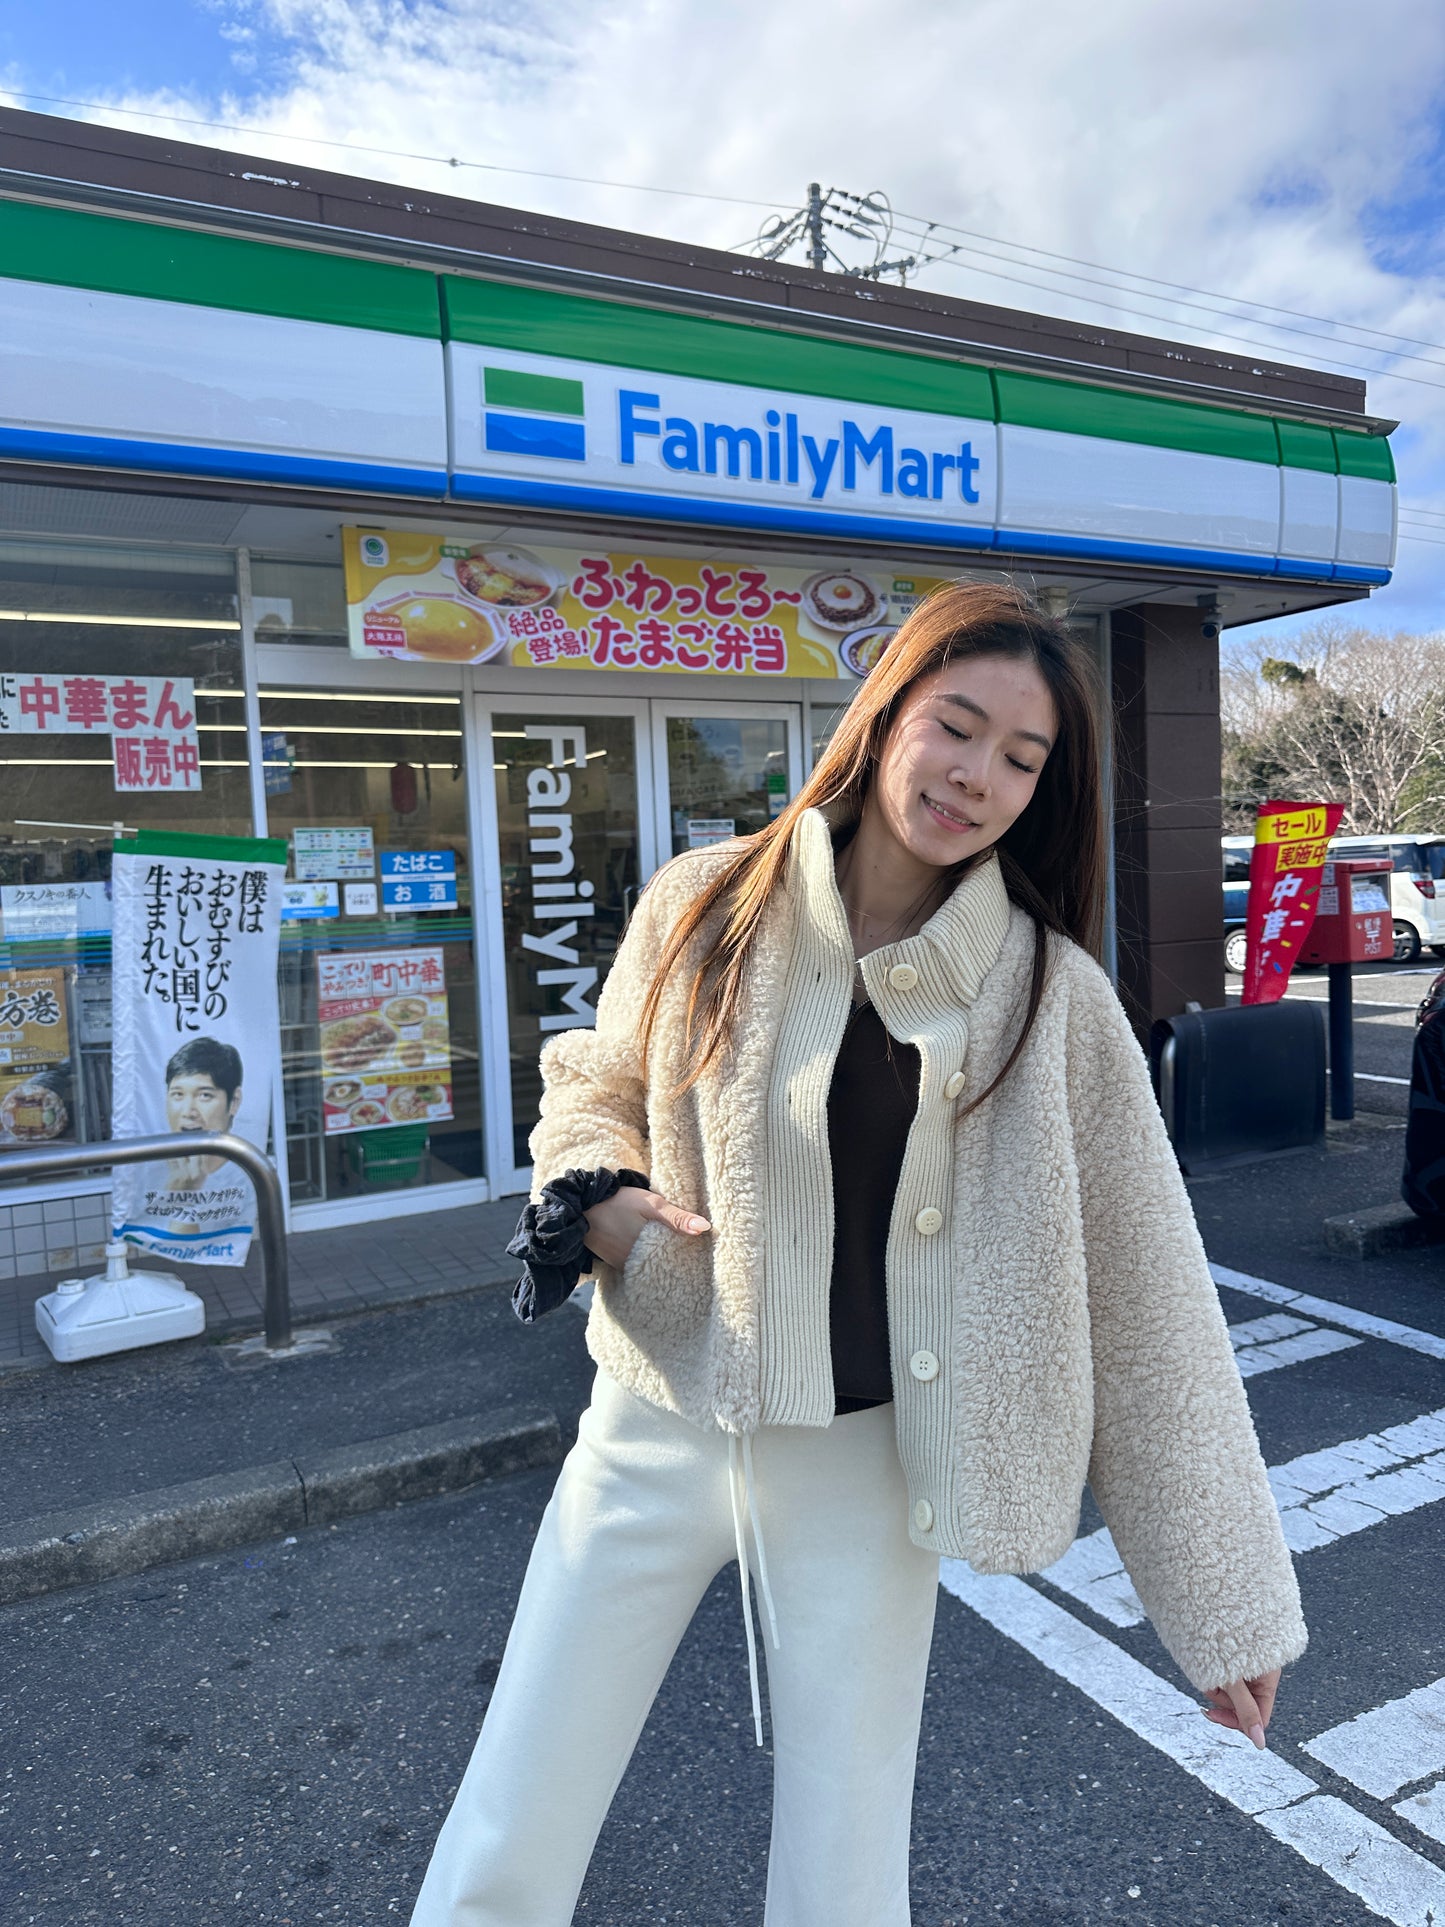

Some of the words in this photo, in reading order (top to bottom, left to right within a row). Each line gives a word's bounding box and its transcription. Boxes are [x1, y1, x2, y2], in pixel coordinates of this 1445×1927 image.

[618, 389, 980, 504] FamilyMart
[508, 608, 565, 639] 絶品
[528, 630, 589, 663] 登場!
[591, 615, 785, 671] たまご弁当
[19, 677, 194, 730] 中華まん
[115, 736, 199, 787] 販売中
[1272, 813, 1322, 838] セール
[392, 854, 444, 872] たばこ
[525, 725, 598, 1034] FamilyM
[14, 887, 92, 905] クスノキの番人
[239, 870, 269, 933] 僕は
[140, 864, 174, 1003] 生まれた。
[172, 866, 206, 1032] おいしい国に
[204, 868, 238, 1021] おむすびの
[1364, 942, 1382, 955] POST
[372, 957, 442, 988] 町中華
